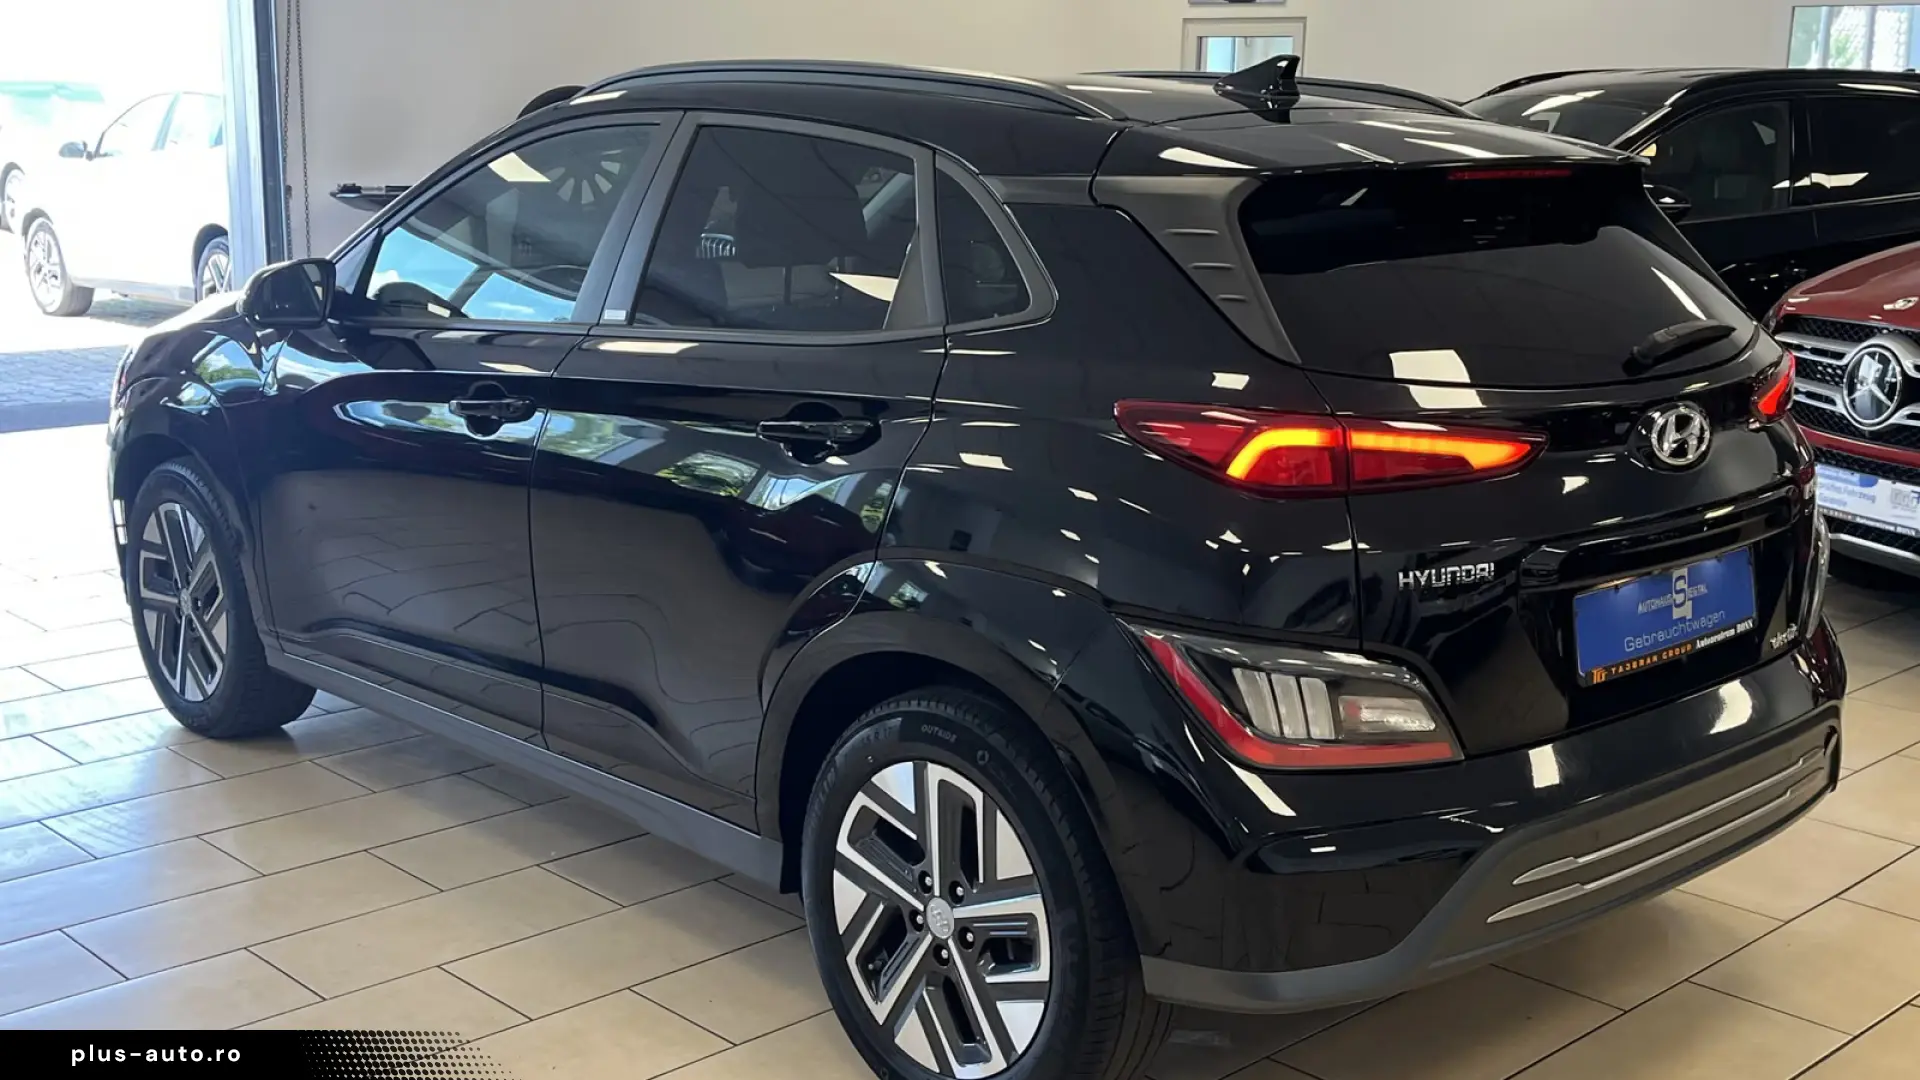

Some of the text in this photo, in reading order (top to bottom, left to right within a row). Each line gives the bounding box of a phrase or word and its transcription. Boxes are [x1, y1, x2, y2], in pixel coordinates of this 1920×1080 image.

[1398, 562, 1495, 591] HYUNDAI
[1624, 609, 1726, 652] Gebrauchtwagen
[1661, 643, 1692, 660] GROUP
[921, 724, 957, 743] OUTSIDE
